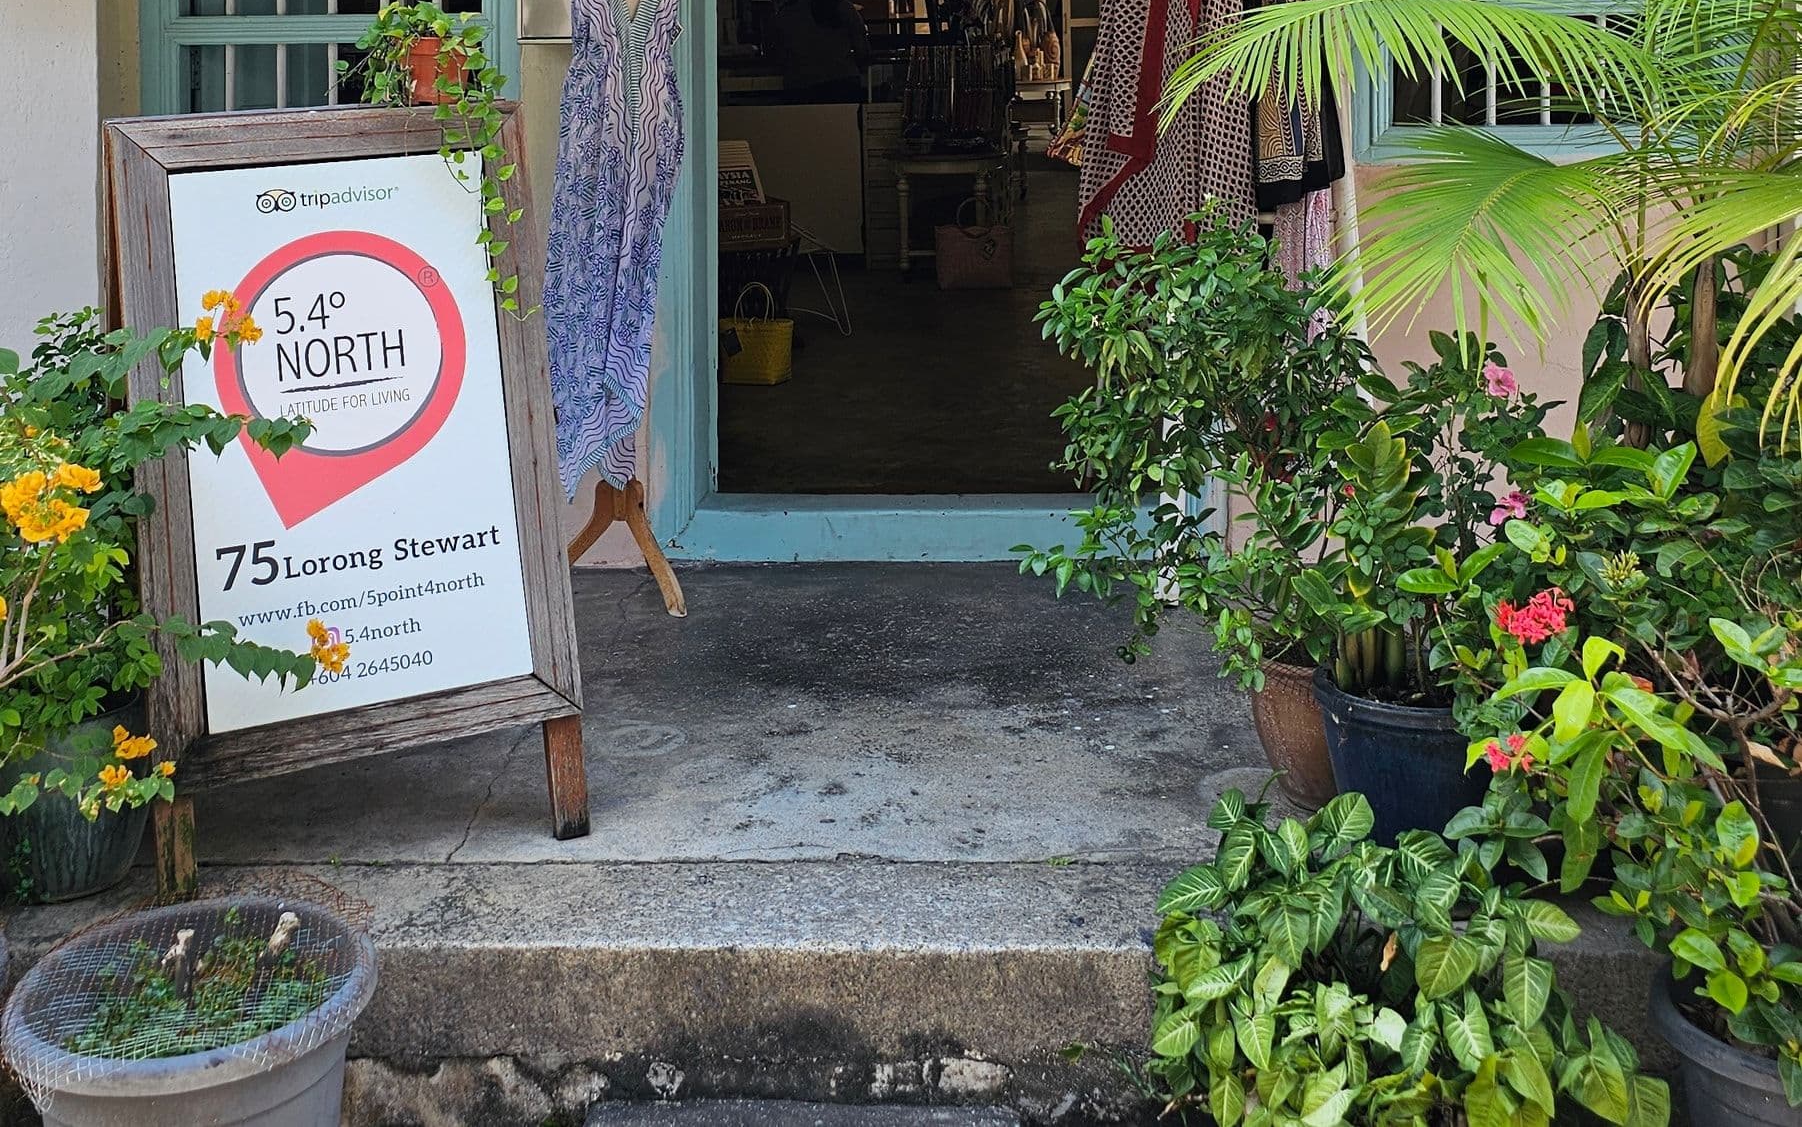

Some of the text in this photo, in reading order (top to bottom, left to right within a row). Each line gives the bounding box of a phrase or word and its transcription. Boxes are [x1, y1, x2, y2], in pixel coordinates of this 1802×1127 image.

[277, 329, 406, 382] NORTH
[280, 388, 410, 417] LATITUDE FOR LIVING
[215, 524, 501, 592] 75 Lorong Stewart
[238, 572, 485, 628] www.fb.com/5point4north
[345, 618, 422, 644] 5.4north
[356, 650, 433, 678] 2645040
